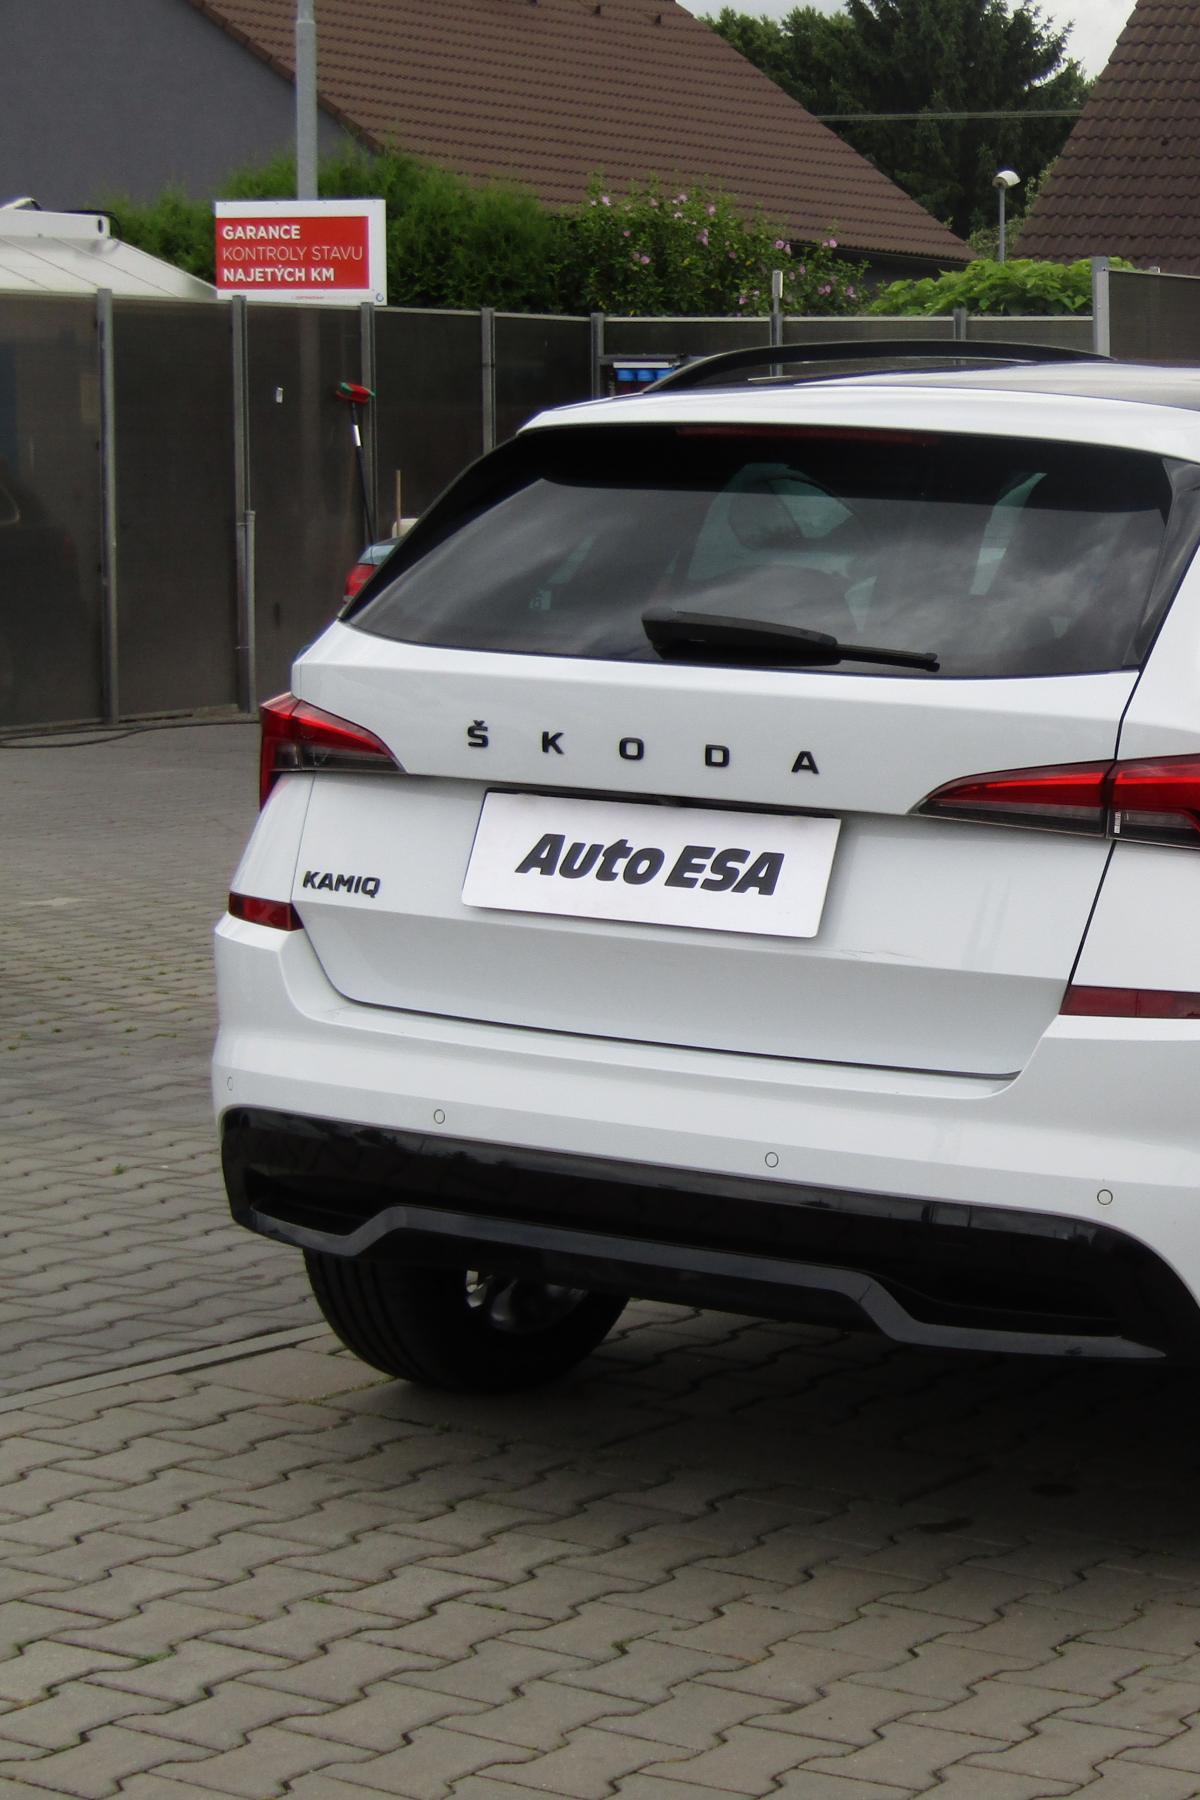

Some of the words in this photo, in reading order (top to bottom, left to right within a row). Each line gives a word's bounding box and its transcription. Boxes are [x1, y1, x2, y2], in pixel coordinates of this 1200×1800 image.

[222, 225, 301, 240] GARANCE
[223, 246, 308, 261] KONTROLY
[311, 245, 363, 261] STAVU
[223, 264, 305, 282] NAJETÝCH
[311, 268, 335, 282] KM
[467, 720, 820, 774] ŠKODA
[514, 833, 665, 885] Auto
[664, 845, 785, 896] ESA
[302, 870, 381, 898] KAMIQ
